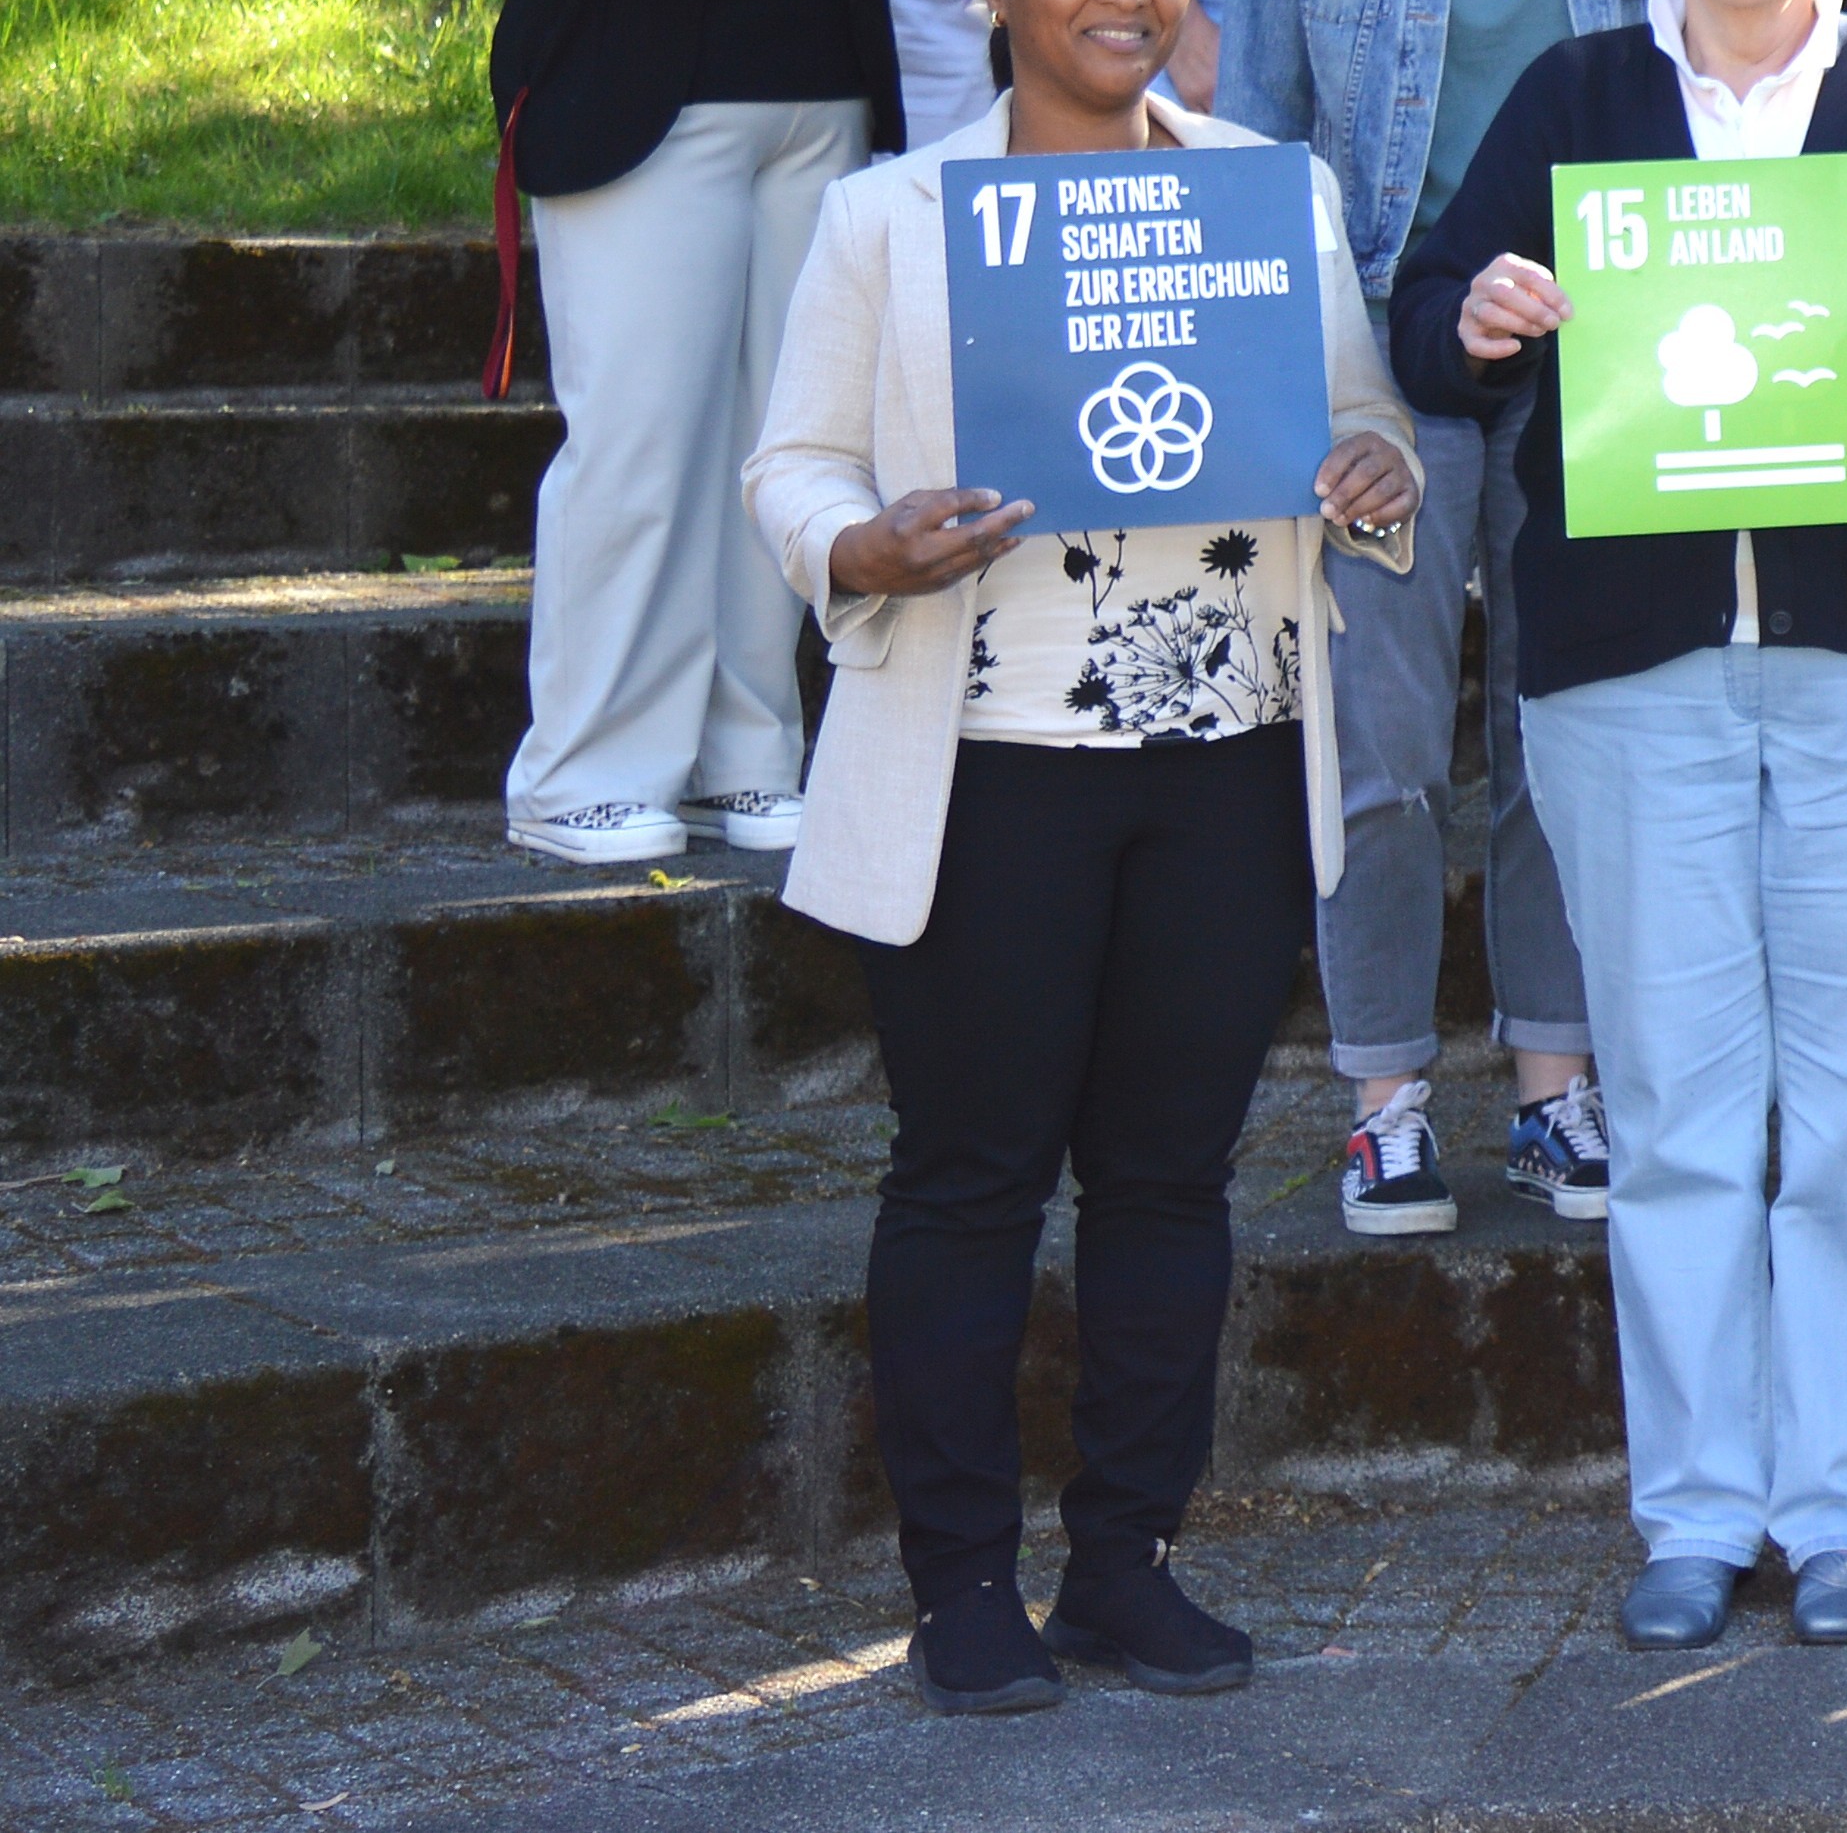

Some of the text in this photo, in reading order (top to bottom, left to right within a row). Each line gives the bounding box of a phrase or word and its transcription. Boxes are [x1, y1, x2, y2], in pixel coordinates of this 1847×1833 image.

[972, 175, 1190, 267] 17 PARTNER-
[1061, 219, 1203, 262] SCHAFTEN
[1577, 184, 1750, 271] 15 LEBEN
[1670, 226, 1785, 266] AN LAND
[1065, 259, 1289, 307] ZUR ERREICHUNG
[1068, 309, 1196, 353] DER ZIELE
